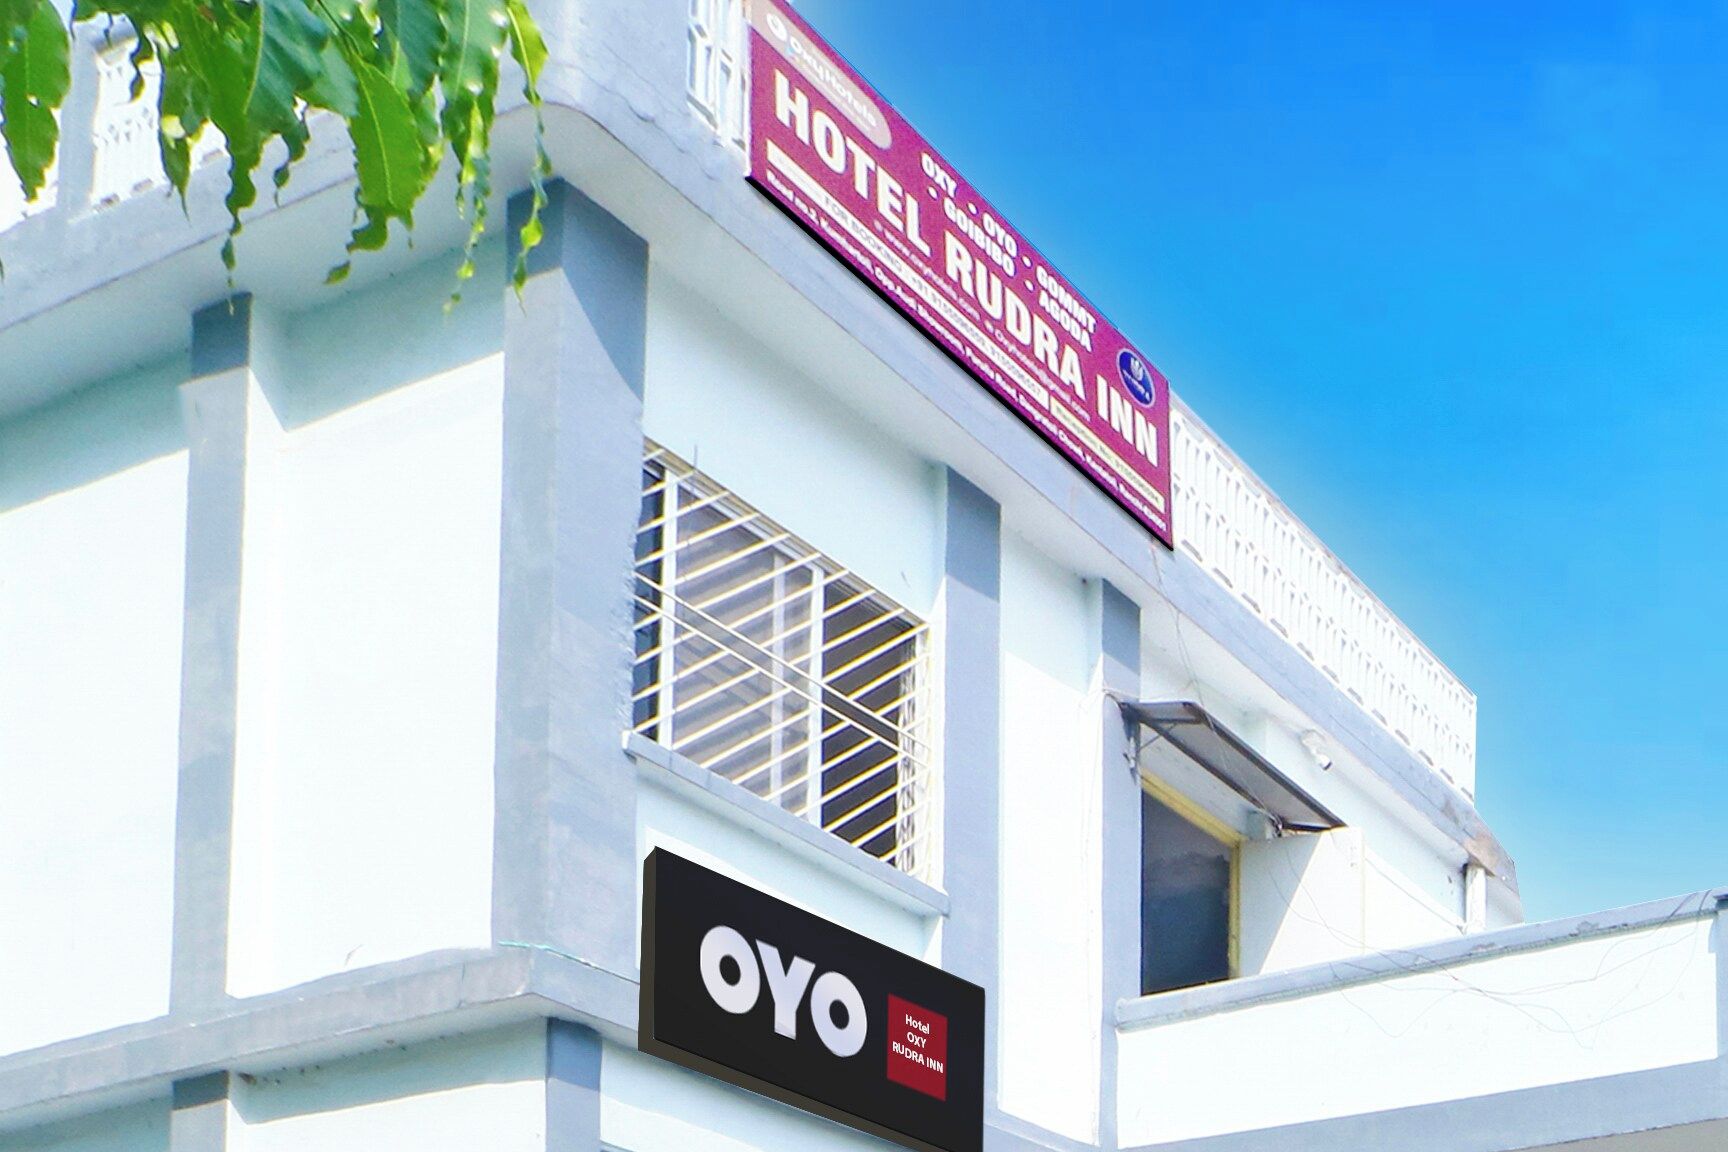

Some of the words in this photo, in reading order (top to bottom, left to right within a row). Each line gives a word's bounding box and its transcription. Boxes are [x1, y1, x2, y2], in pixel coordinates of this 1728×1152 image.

[775, 69, 932, 257] HOTEL
[945, 230, 1086, 401] RUDRA
[1096, 372, 1158, 467] INN
[825, 193, 847, 225] FOR
[851, 217, 901, 273] BOOKING
[921, 152, 957, 197] OXY
[983, 212, 1018, 258] OYO
[1035, 265, 1097, 332] GOMMT
[943, 196, 1016, 278] GOIBIBO
[1038, 290, 1093, 352] AGODA
[700, 925, 867, 1057] OYO
[905, 1014, 930, 1035] Hotel
[907, 1031, 927, 1049] OXY
[892, 1041, 925, 1066] RUDRA
[926, 1057, 944, 1073] INN
